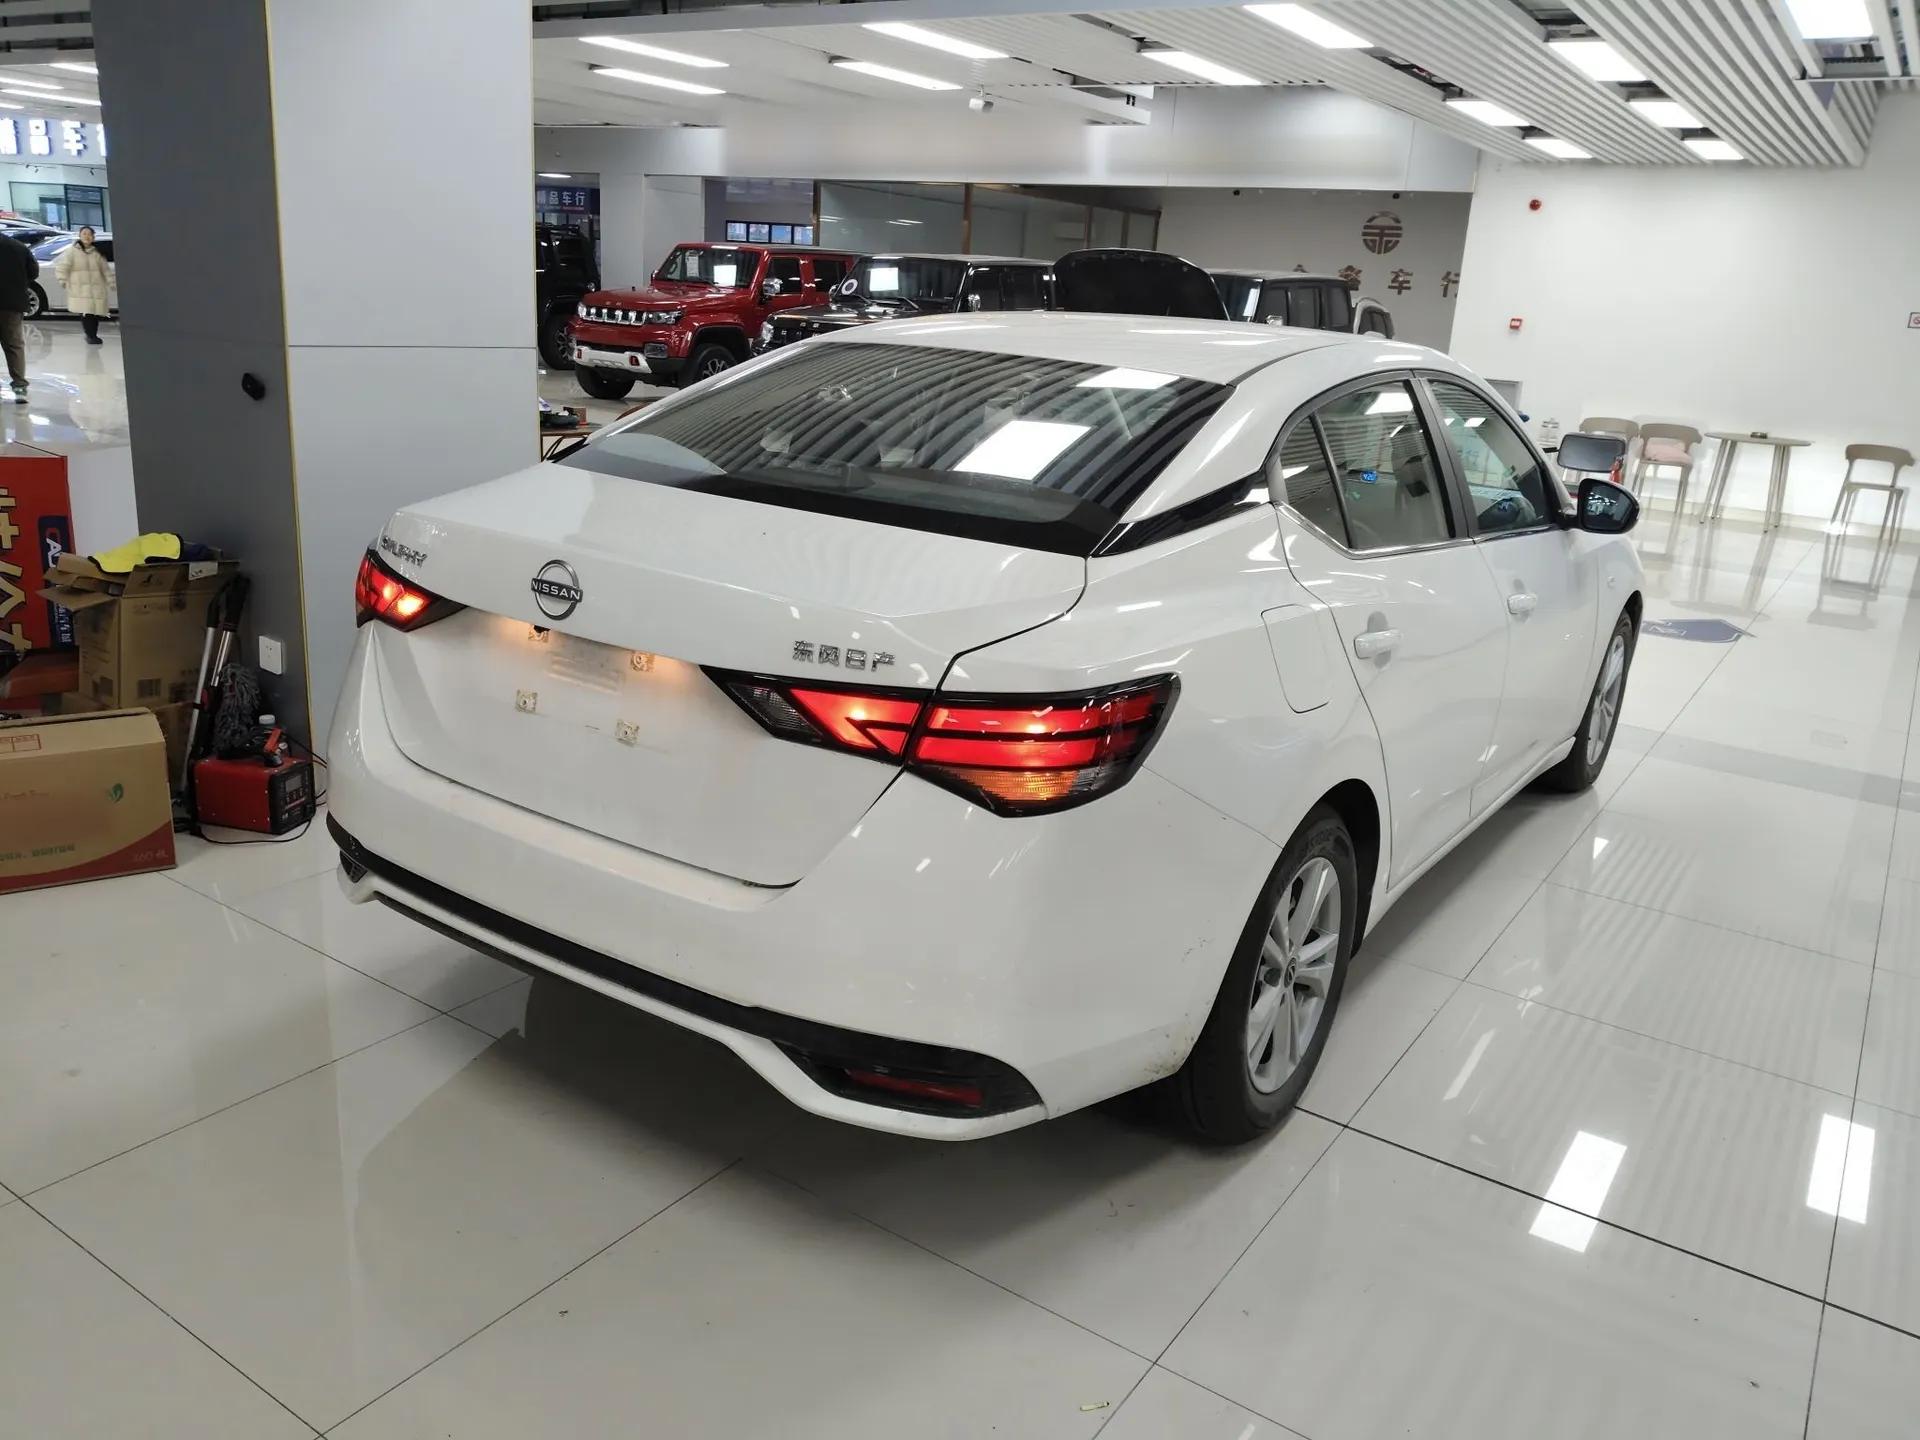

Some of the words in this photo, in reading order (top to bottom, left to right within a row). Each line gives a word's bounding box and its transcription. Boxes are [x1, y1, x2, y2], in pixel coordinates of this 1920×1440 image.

[532, 579, 581, 601] NISSAN
[792, 640, 896, 673] 东风日产
